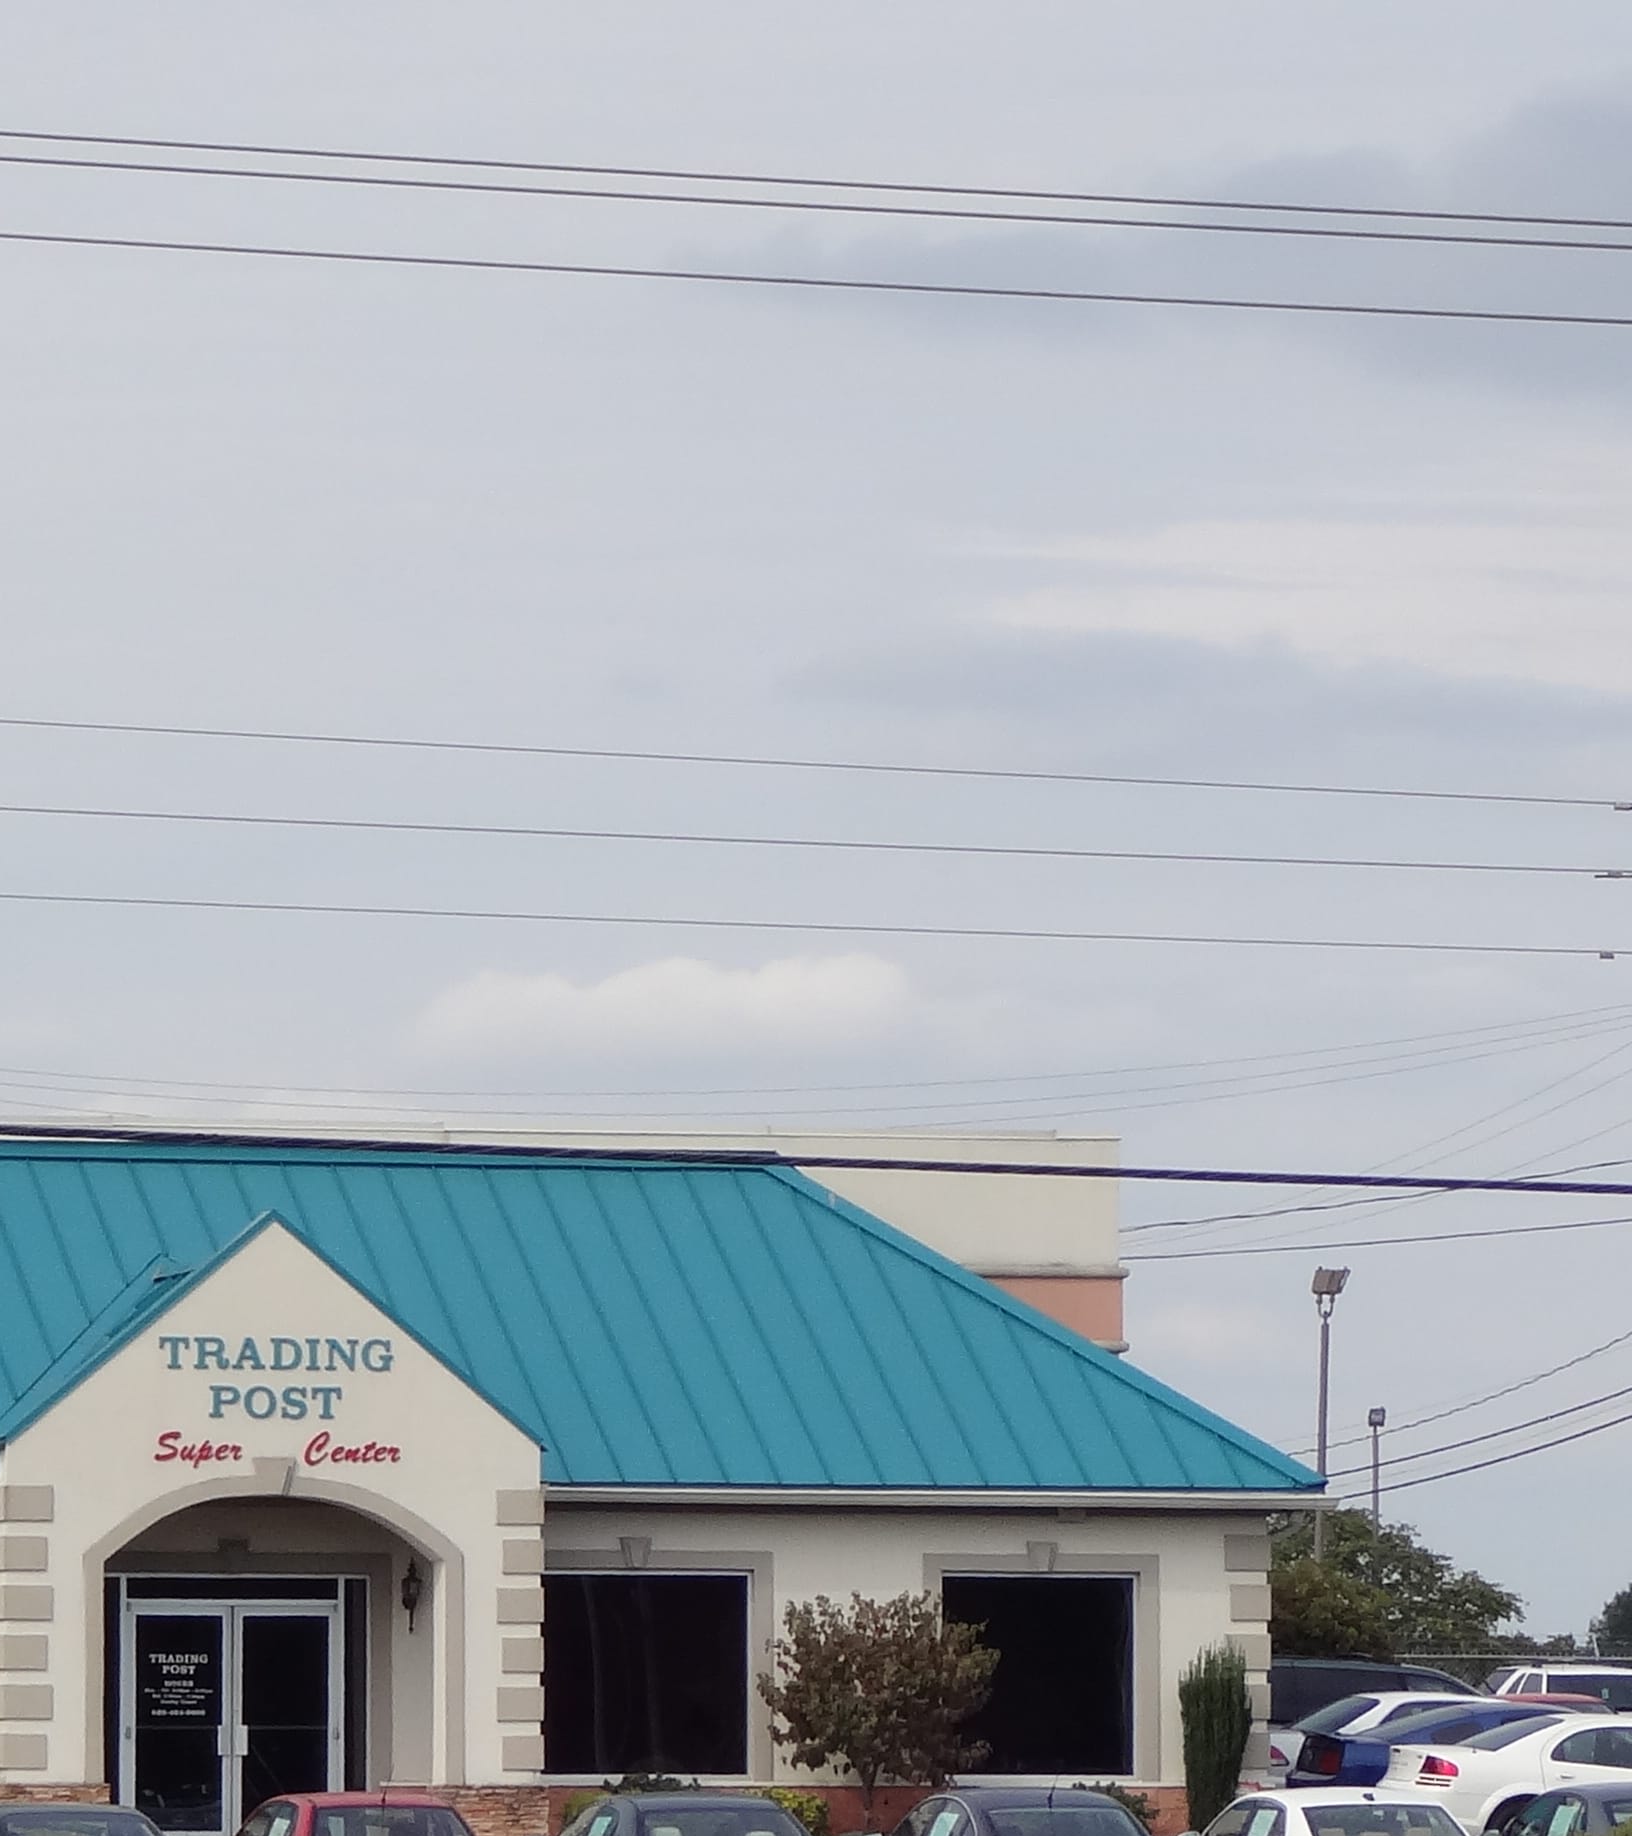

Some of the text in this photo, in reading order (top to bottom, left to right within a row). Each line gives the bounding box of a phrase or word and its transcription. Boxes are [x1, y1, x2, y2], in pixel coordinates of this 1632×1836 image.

[159, 1336, 394, 1372] TRADING
[209, 1385, 343, 1419] POST
[154, 1431, 400, 1468] Super Center
[149, 1654, 209, 1664] TRADING
[162, 1665, 196, 1675] POST
